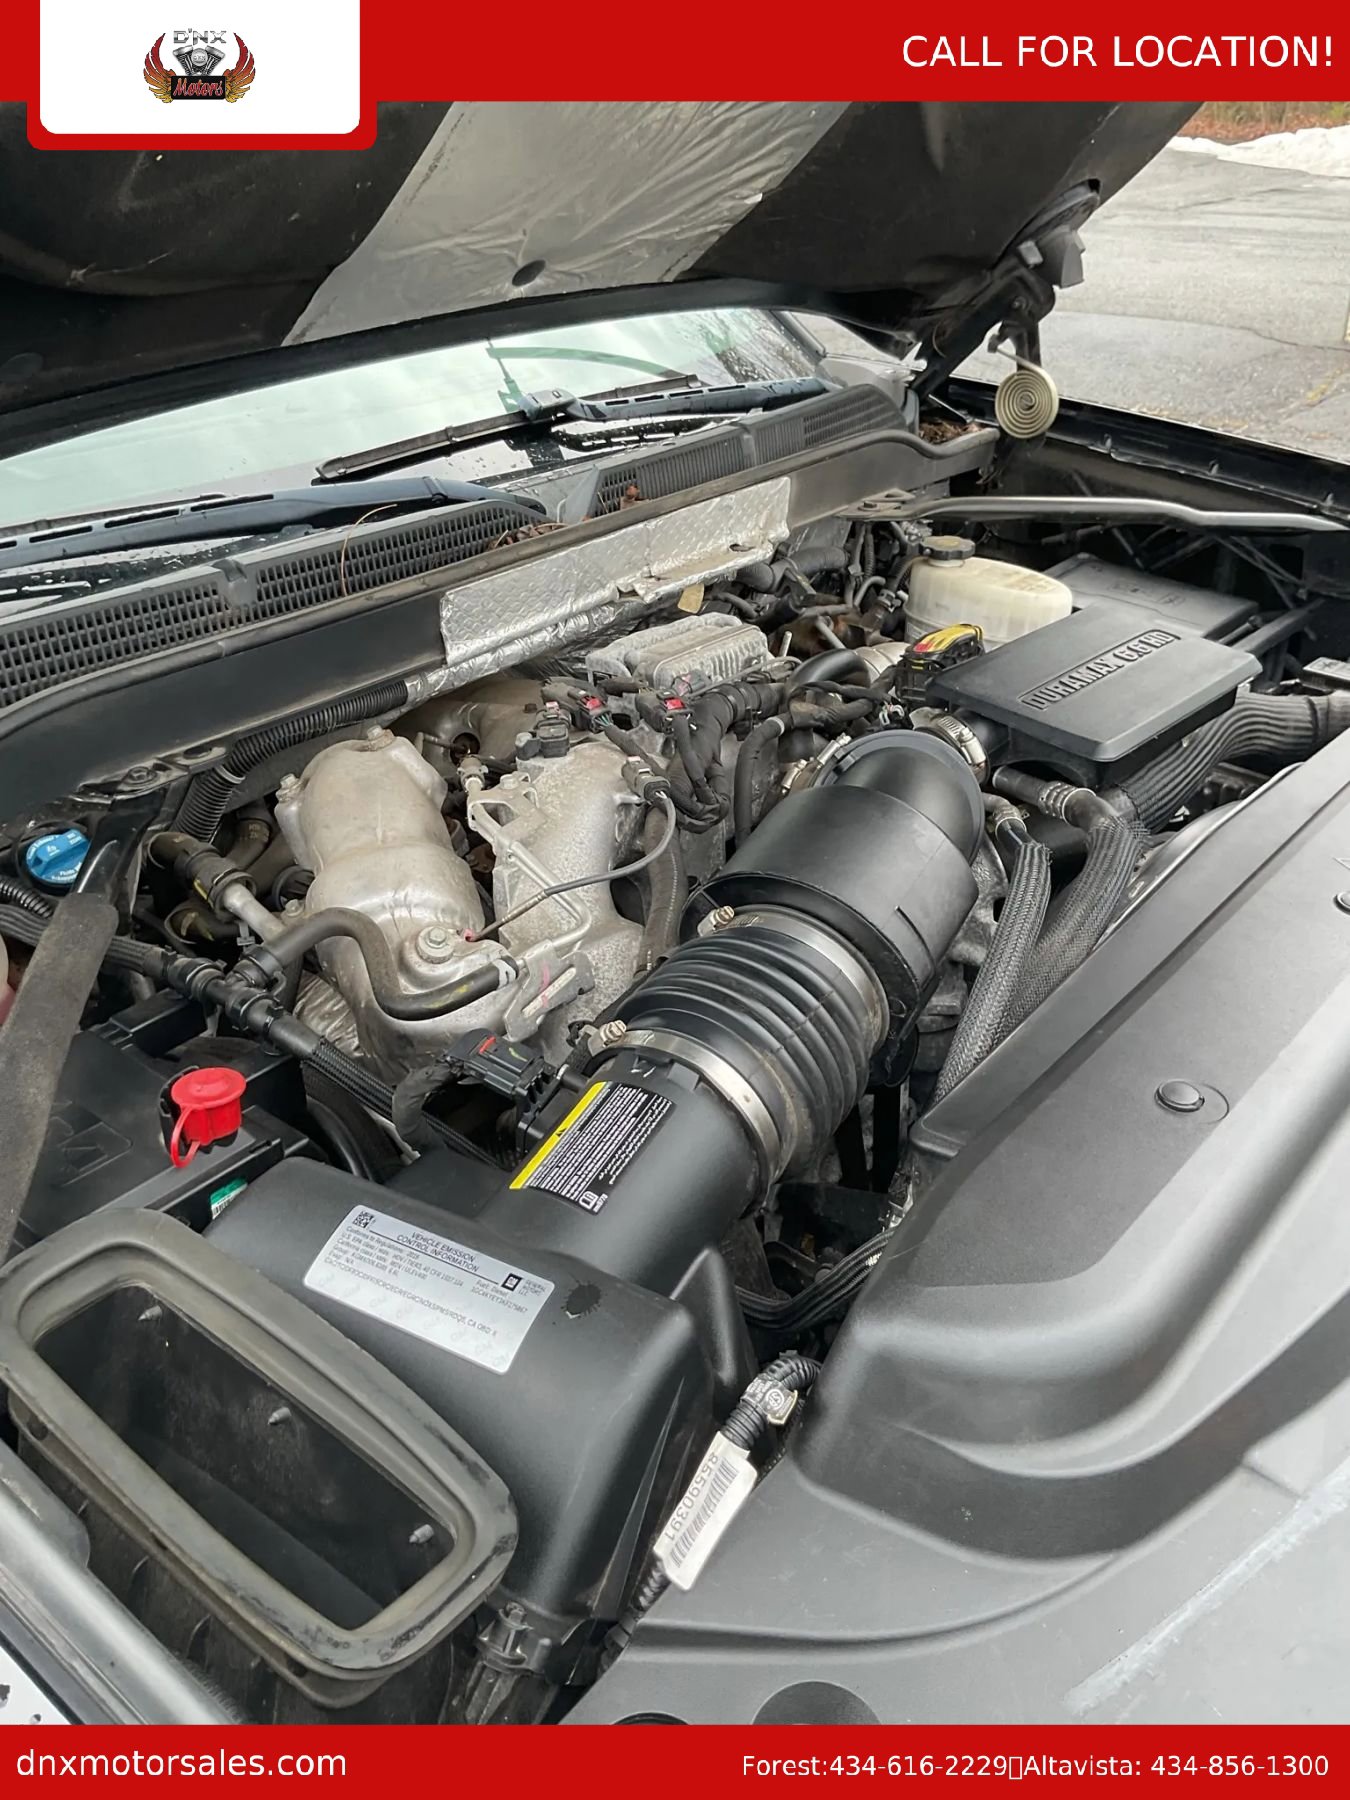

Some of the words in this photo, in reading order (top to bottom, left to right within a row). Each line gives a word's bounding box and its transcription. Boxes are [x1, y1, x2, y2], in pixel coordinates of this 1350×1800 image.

[1020, 658, 1124, 710] DURAMAX
[1113, 643, 1153, 663] 6.6
[1143, 632, 1175, 649] HD
[397, 1234, 429, 1252] CONTROL
[430, 1248, 480, 1272] INFORMATION
[411, 1231, 441, 1249] VEHICLE
[440, 1243, 476, 1263] EMISSION
